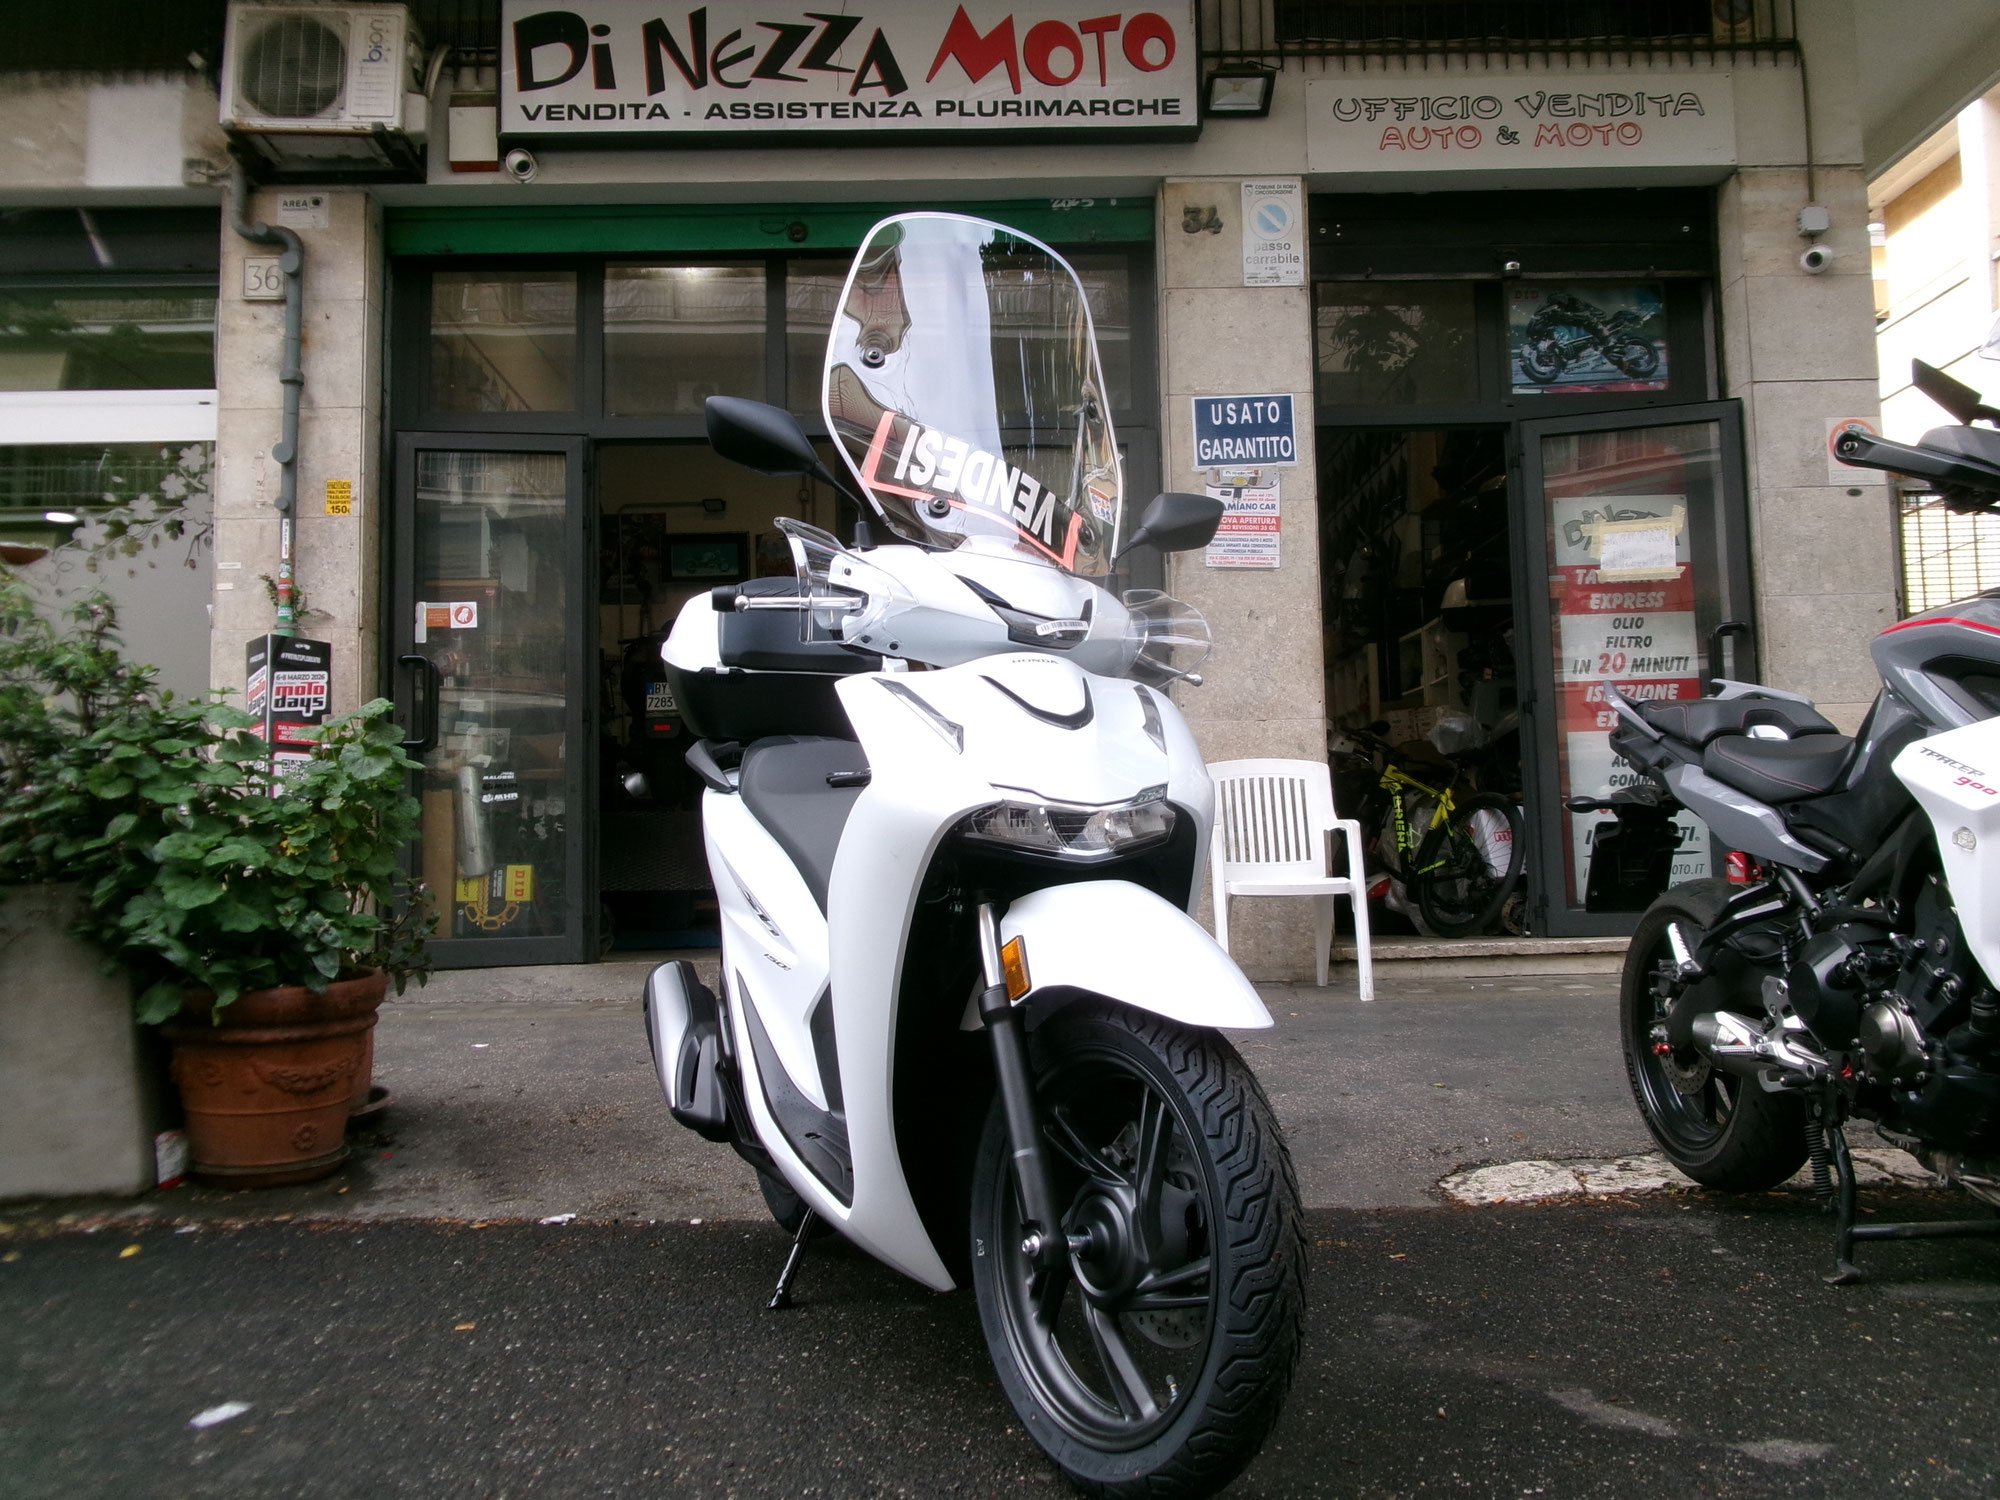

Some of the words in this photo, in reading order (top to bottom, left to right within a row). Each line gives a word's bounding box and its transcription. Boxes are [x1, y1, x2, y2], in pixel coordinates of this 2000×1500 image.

[926, 3, 1176, 94] MOTO
[520, 103, 670, 121] VENDITA
[704, 101, 922, 119] ASSISTENZA
[935, 98, 1180, 117] PLURIMARCHE
[1333, 96, 1503, 122] UFFICIO
[1514, 91, 1704, 119] VENDITA
[1379, 126, 1482, 150] AUTO
[1496, 125, 1520, 145] &
[1534, 122, 1643, 147] MOTO
[1182, 205, 1223, 234] 34
[1245, 253, 1300, 264] carrabile
[1254, 242, 1291, 254] passo
[247, 264, 280, 291] 36
[1211, 401, 1280, 425] USATO
[1199, 436, 1292, 460] GARANTITO
[894, 424, 1056, 546] VENDESI
[1259, 503, 1276, 511] CAR
[1239, 517, 1277, 525] APERTURA
[1589, 592, 1666, 610] EXPRESS
[1612, 617, 1644, 629] OLIO
[1606, 636, 1653, 648] FILTRO
[1572, 659, 1592, 674] IN
[1598, 652, 1627, 674] 20
[1630, 656, 1690, 673] MINUTI
[655, 683, 668, 694] BY
[274, 695, 324, 714] days
[1920, 746, 1986, 776] TRACER
[1953, 776, 1999, 795] 900
[514, 870, 525, 897] DID
